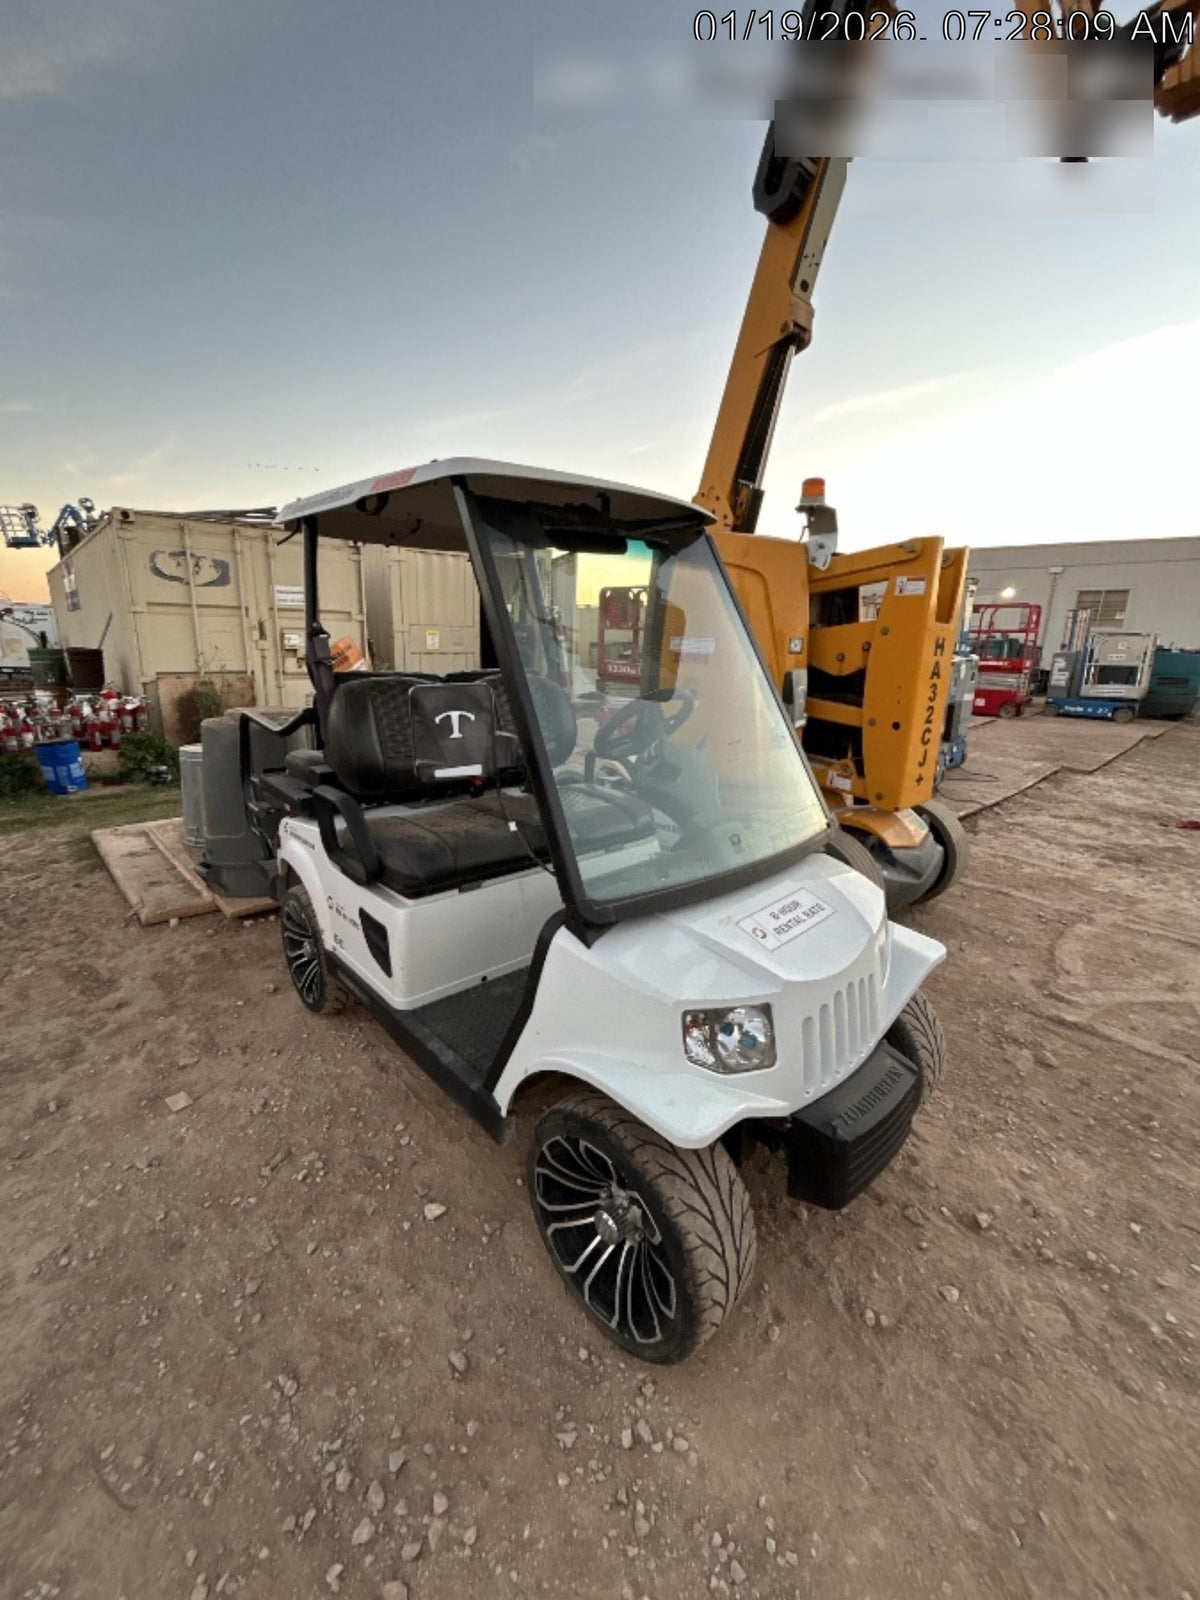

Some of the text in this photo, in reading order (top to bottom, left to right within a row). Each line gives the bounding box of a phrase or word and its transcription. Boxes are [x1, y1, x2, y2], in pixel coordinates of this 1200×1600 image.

[434, 710, 476, 739] T
[915, 636, 946, 787] HA32CJ+
[773, 902, 826, 936] RENTAL RATE
